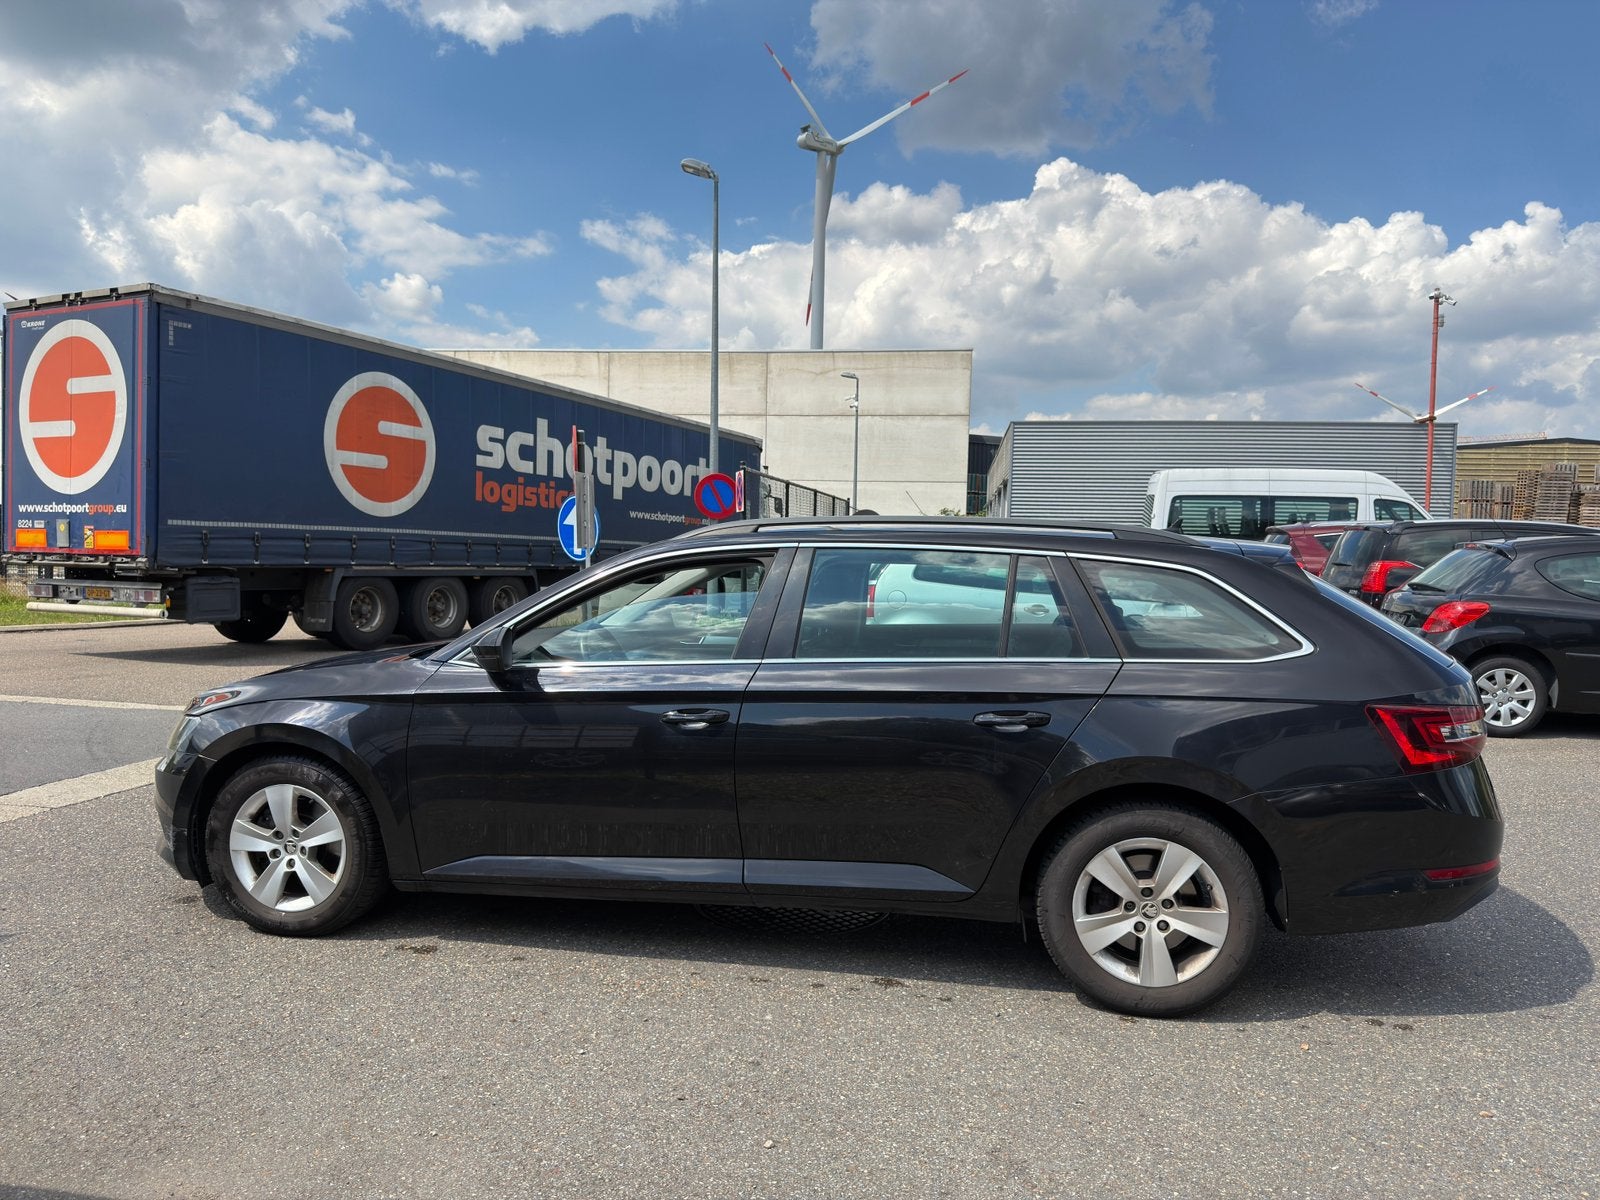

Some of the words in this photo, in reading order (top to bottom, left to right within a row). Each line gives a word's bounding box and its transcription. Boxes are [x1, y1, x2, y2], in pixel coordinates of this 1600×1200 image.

[475, 470, 575, 513] logistic
[18, 501, 127, 515] www.schotpoortgroup.eu
[17, 519, 33, 529] 8224
